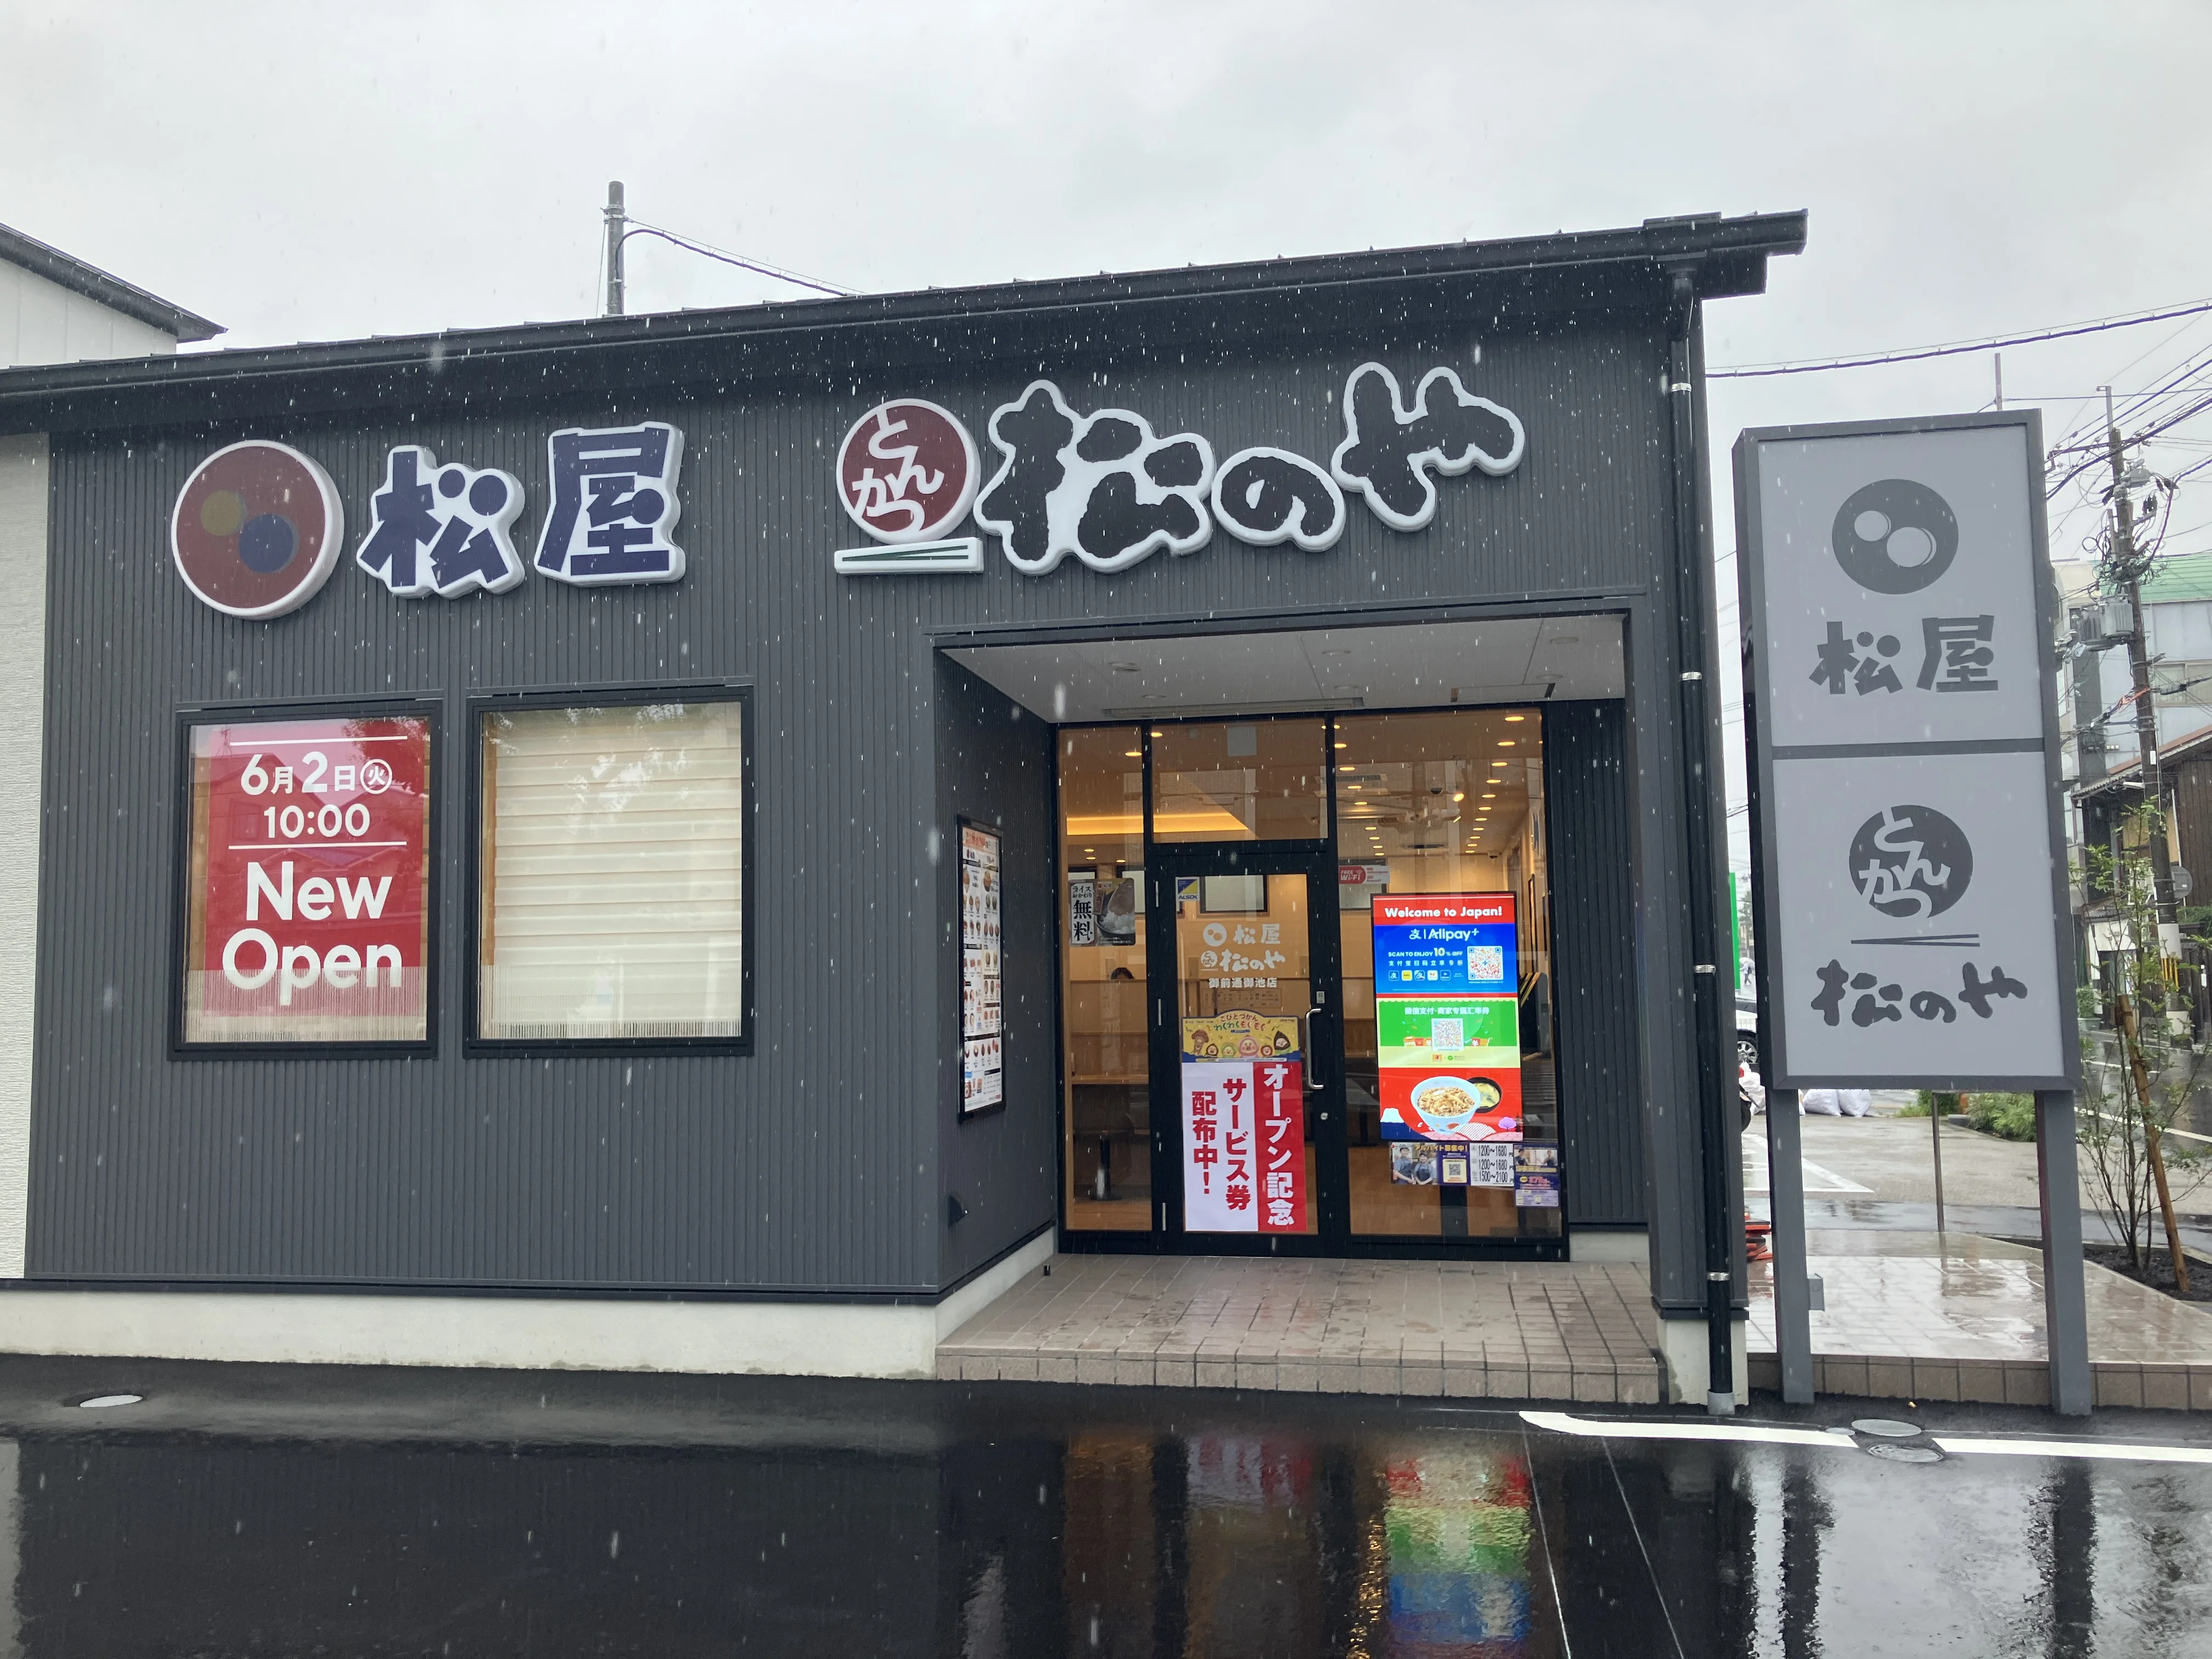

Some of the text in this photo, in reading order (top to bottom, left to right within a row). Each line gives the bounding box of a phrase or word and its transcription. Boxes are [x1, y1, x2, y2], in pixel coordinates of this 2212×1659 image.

[974, 362, 1526, 574] 松のや
[357, 421, 685, 599] 松屋
[1809, 614, 1999, 696] 松屋
[264, 803, 370, 838] 10:00
[246, 861, 393, 921] New
[1073, 900, 1093, 941] 無料
[1385, 906, 1502, 919] Welcome to Japan!
[1219, 949, 1285, 972] 松のや
[1233, 923, 1280, 944] 松屋
[222, 928, 402, 1006] Open
[1209, 977, 1277, 988] 御前通御池店
[1811, 959, 2028, 1027] 松のや
[1223, 1078, 1251, 1211] サービス券
[1264, 1064, 1295, 1226] オープン記念
